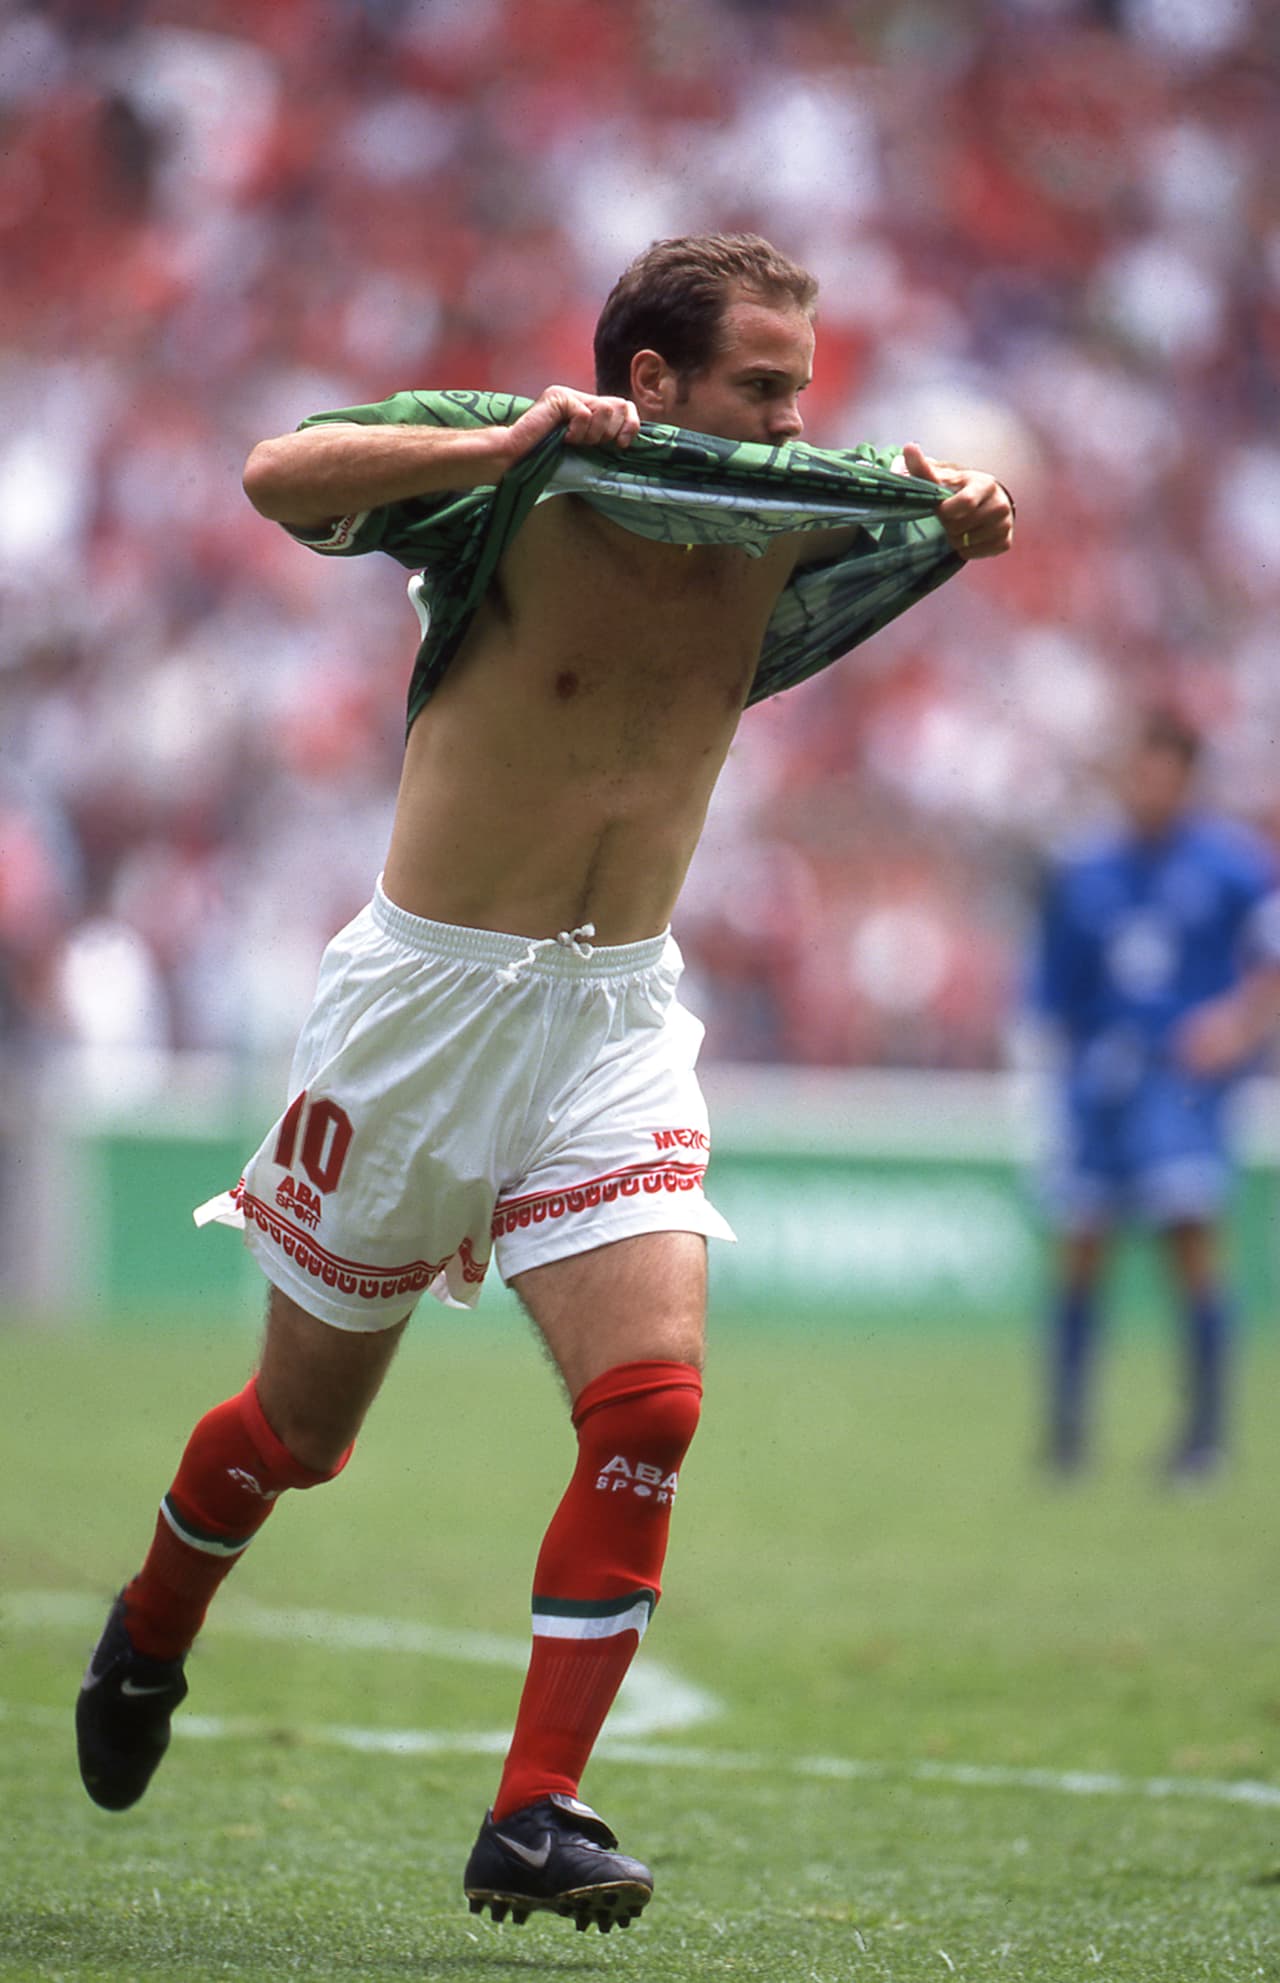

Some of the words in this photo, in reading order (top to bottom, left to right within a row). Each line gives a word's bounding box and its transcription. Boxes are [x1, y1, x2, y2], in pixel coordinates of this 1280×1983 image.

[273, 1089, 355, 1195] 10
[275, 1193, 321, 1231] SPORT
[276, 1175, 322, 1220] ABA
[600, 1455, 678, 1493] ABA
